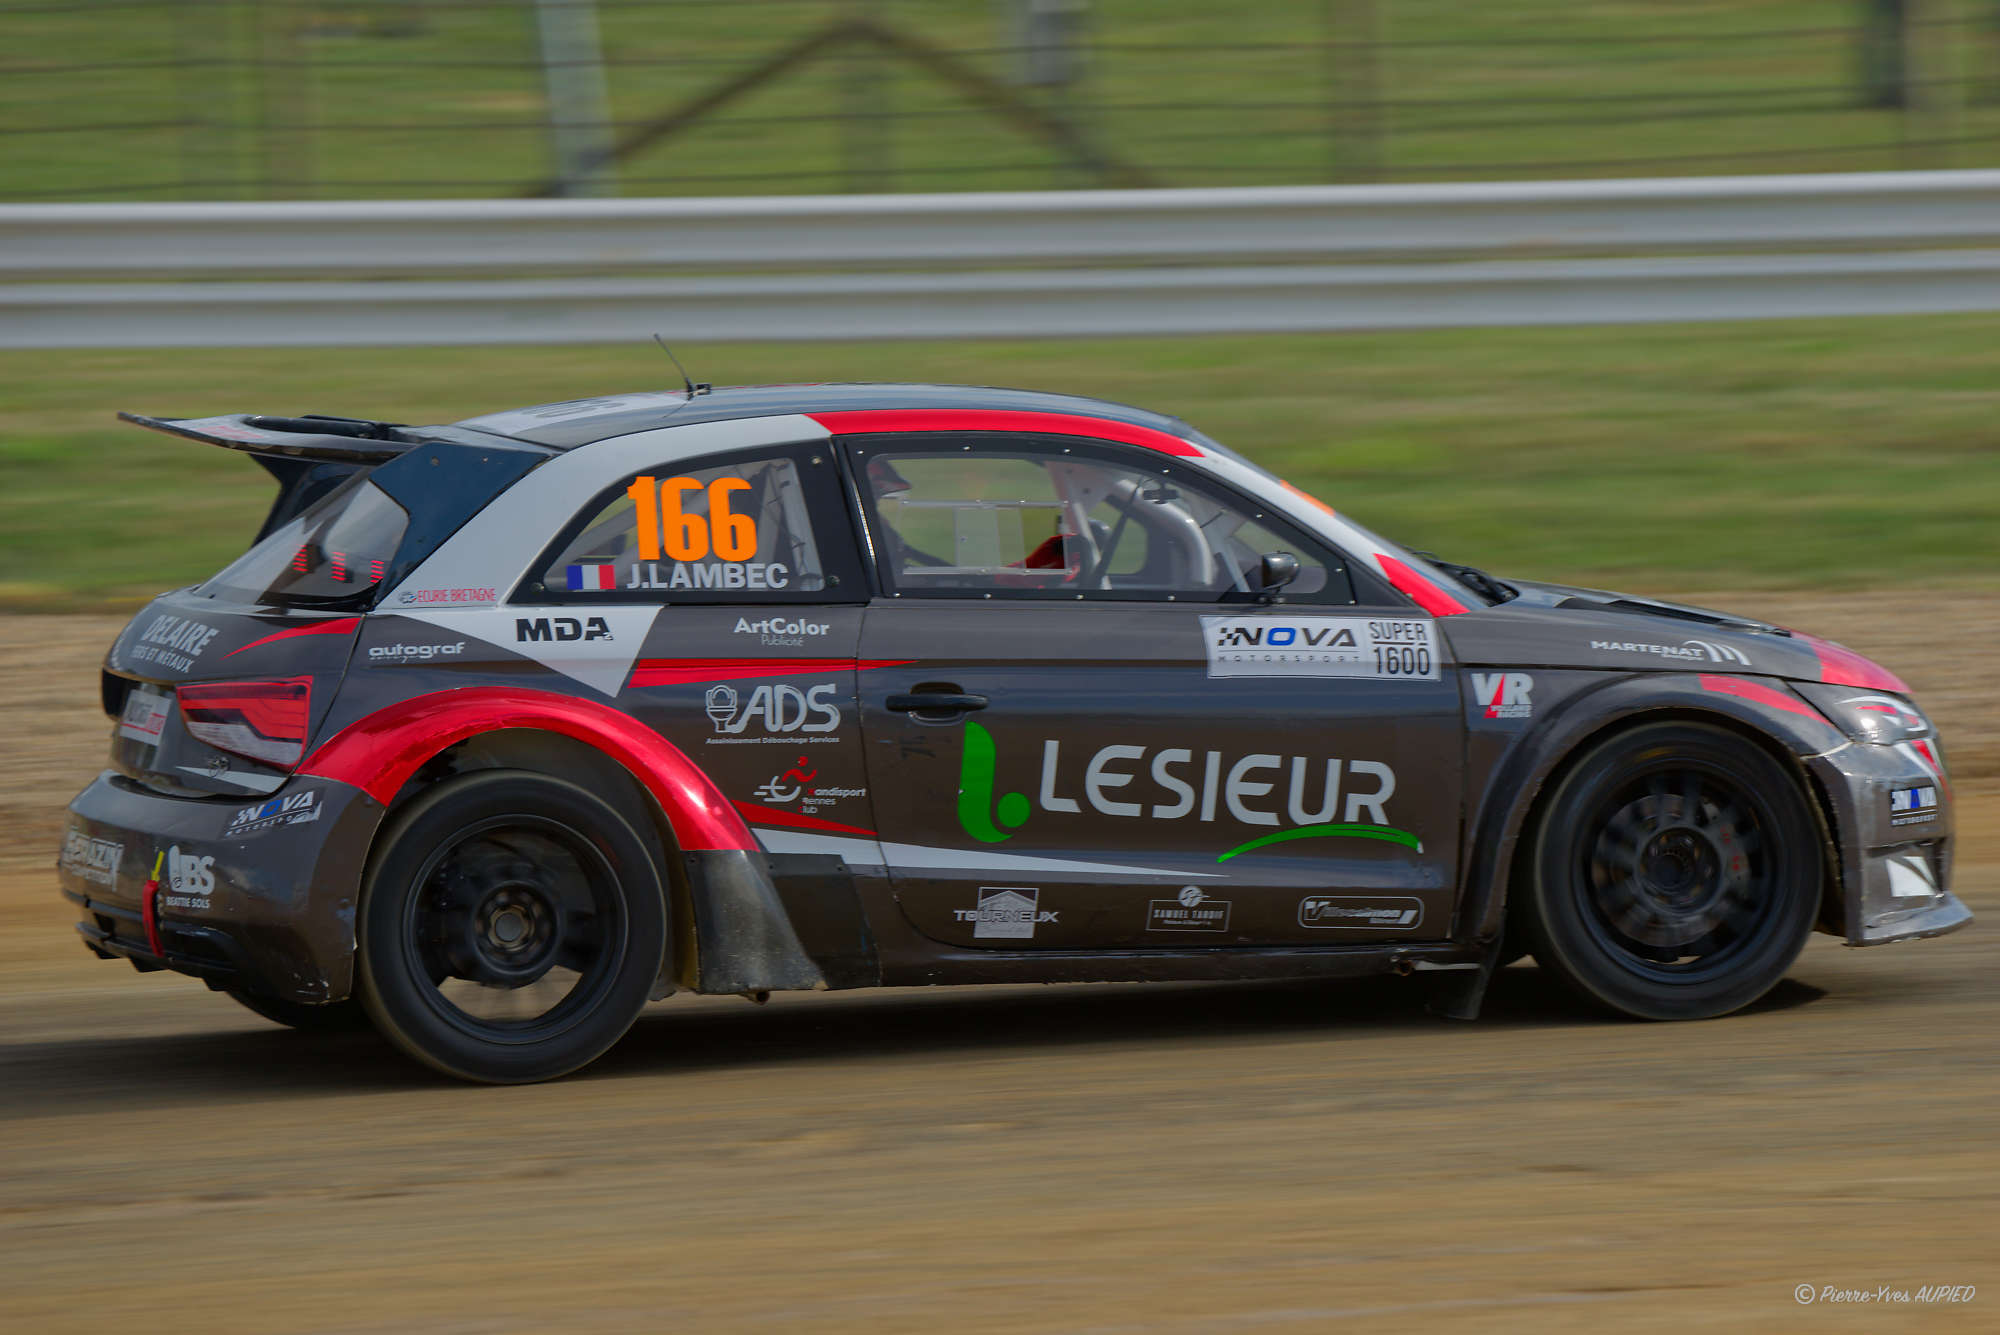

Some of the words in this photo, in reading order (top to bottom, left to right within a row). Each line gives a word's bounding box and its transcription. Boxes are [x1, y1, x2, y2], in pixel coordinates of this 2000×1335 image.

[627, 476, 758, 562] 166
[626, 563, 789, 589] J.LAMBEC
[416, 590, 449, 602] ECURIE
[450, 588, 497, 602] BRETAGNE
[141, 614, 220, 657] DELAIRE
[734, 617, 830, 636] ArtColor
[1369, 621, 1428, 642] SUPER
[1230, 627, 1358, 648] NOVA
[368, 641, 466, 659] autograf
[1218, 654, 1360, 663] MOTORSPORT
[1590, 640, 1704, 658] MARTENAT
[1375, 648, 1431, 676] 1600
[728, 683, 841, 734] ADS
[1039, 739, 1397, 826] LESIEUR
[953, 909, 1060, 923] TOURNEUX
